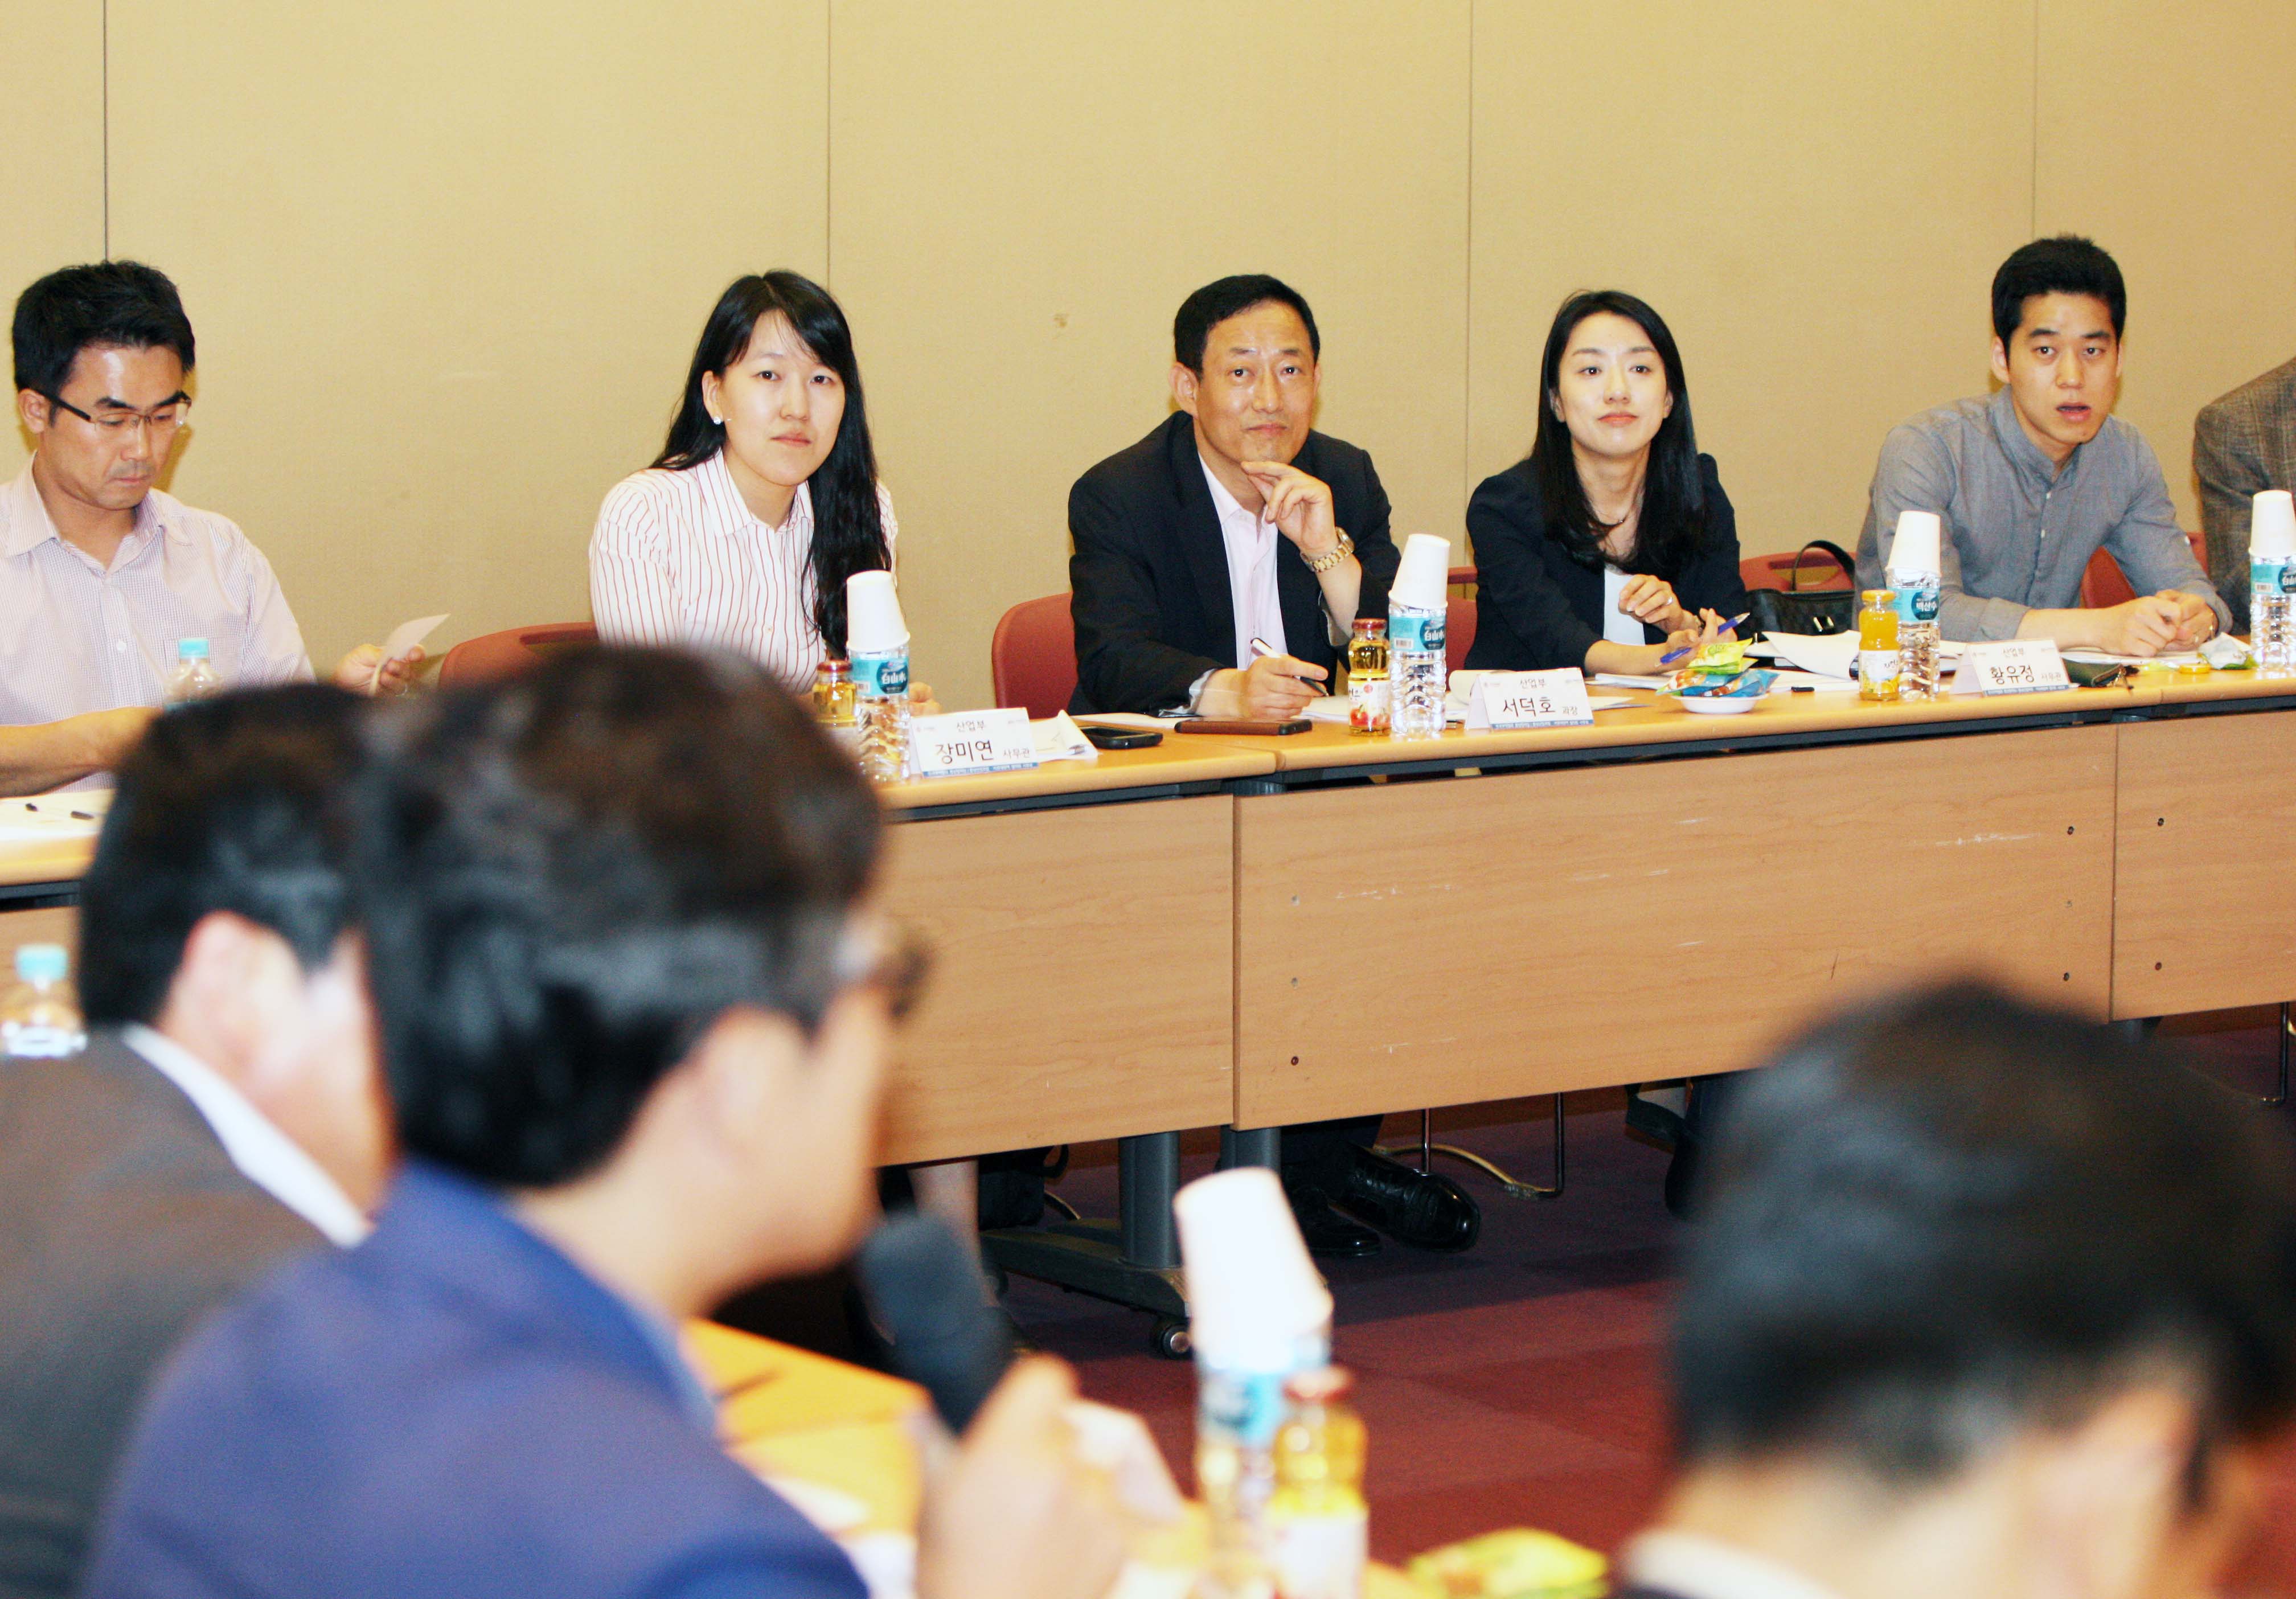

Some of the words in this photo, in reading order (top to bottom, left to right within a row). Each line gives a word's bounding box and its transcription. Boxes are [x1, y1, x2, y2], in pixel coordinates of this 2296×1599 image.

[1916, 601, 1937, 612] 백산수
[1424, 629, 1445, 641] 白山水
[881, 671, 907, 684] 白山水
[1990, 665, 2035, 684] 황유정
[1520, 678, 1545, 689] 산업부
[1503, 697, 1556, 717] 서덕호
[1562, 706, 1578, 716] 과장
[956, 720, 986, 732] 산업부
[936, 740, 994, 764] 장미연
[1003, 748, 1030, 758] 사무관
